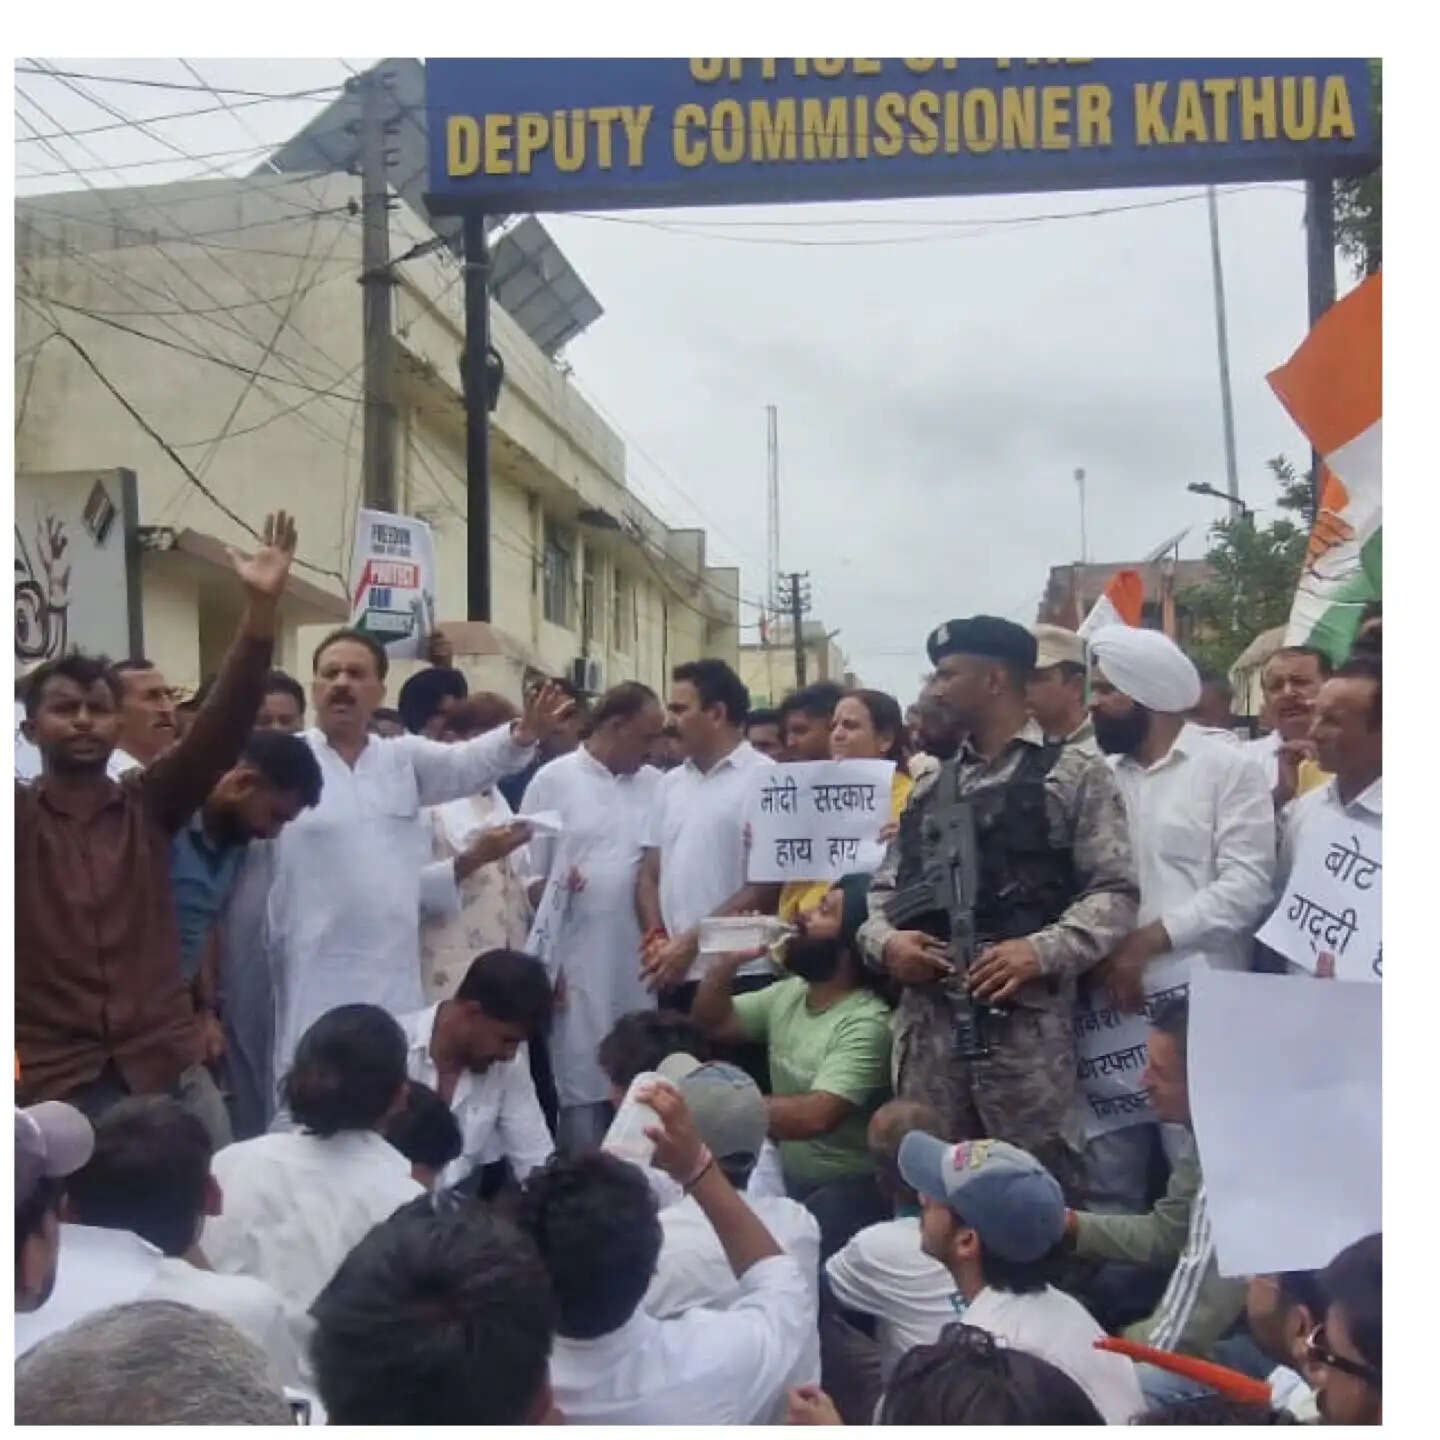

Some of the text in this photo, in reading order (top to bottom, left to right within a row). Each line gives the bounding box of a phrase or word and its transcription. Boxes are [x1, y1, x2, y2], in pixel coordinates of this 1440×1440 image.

[448, 74, 1356, 177] DEPUTY COMMISSIONER KATHUA
[812, 784, 876, 813] सरकार
[774, 838, 813, 867] हाय
